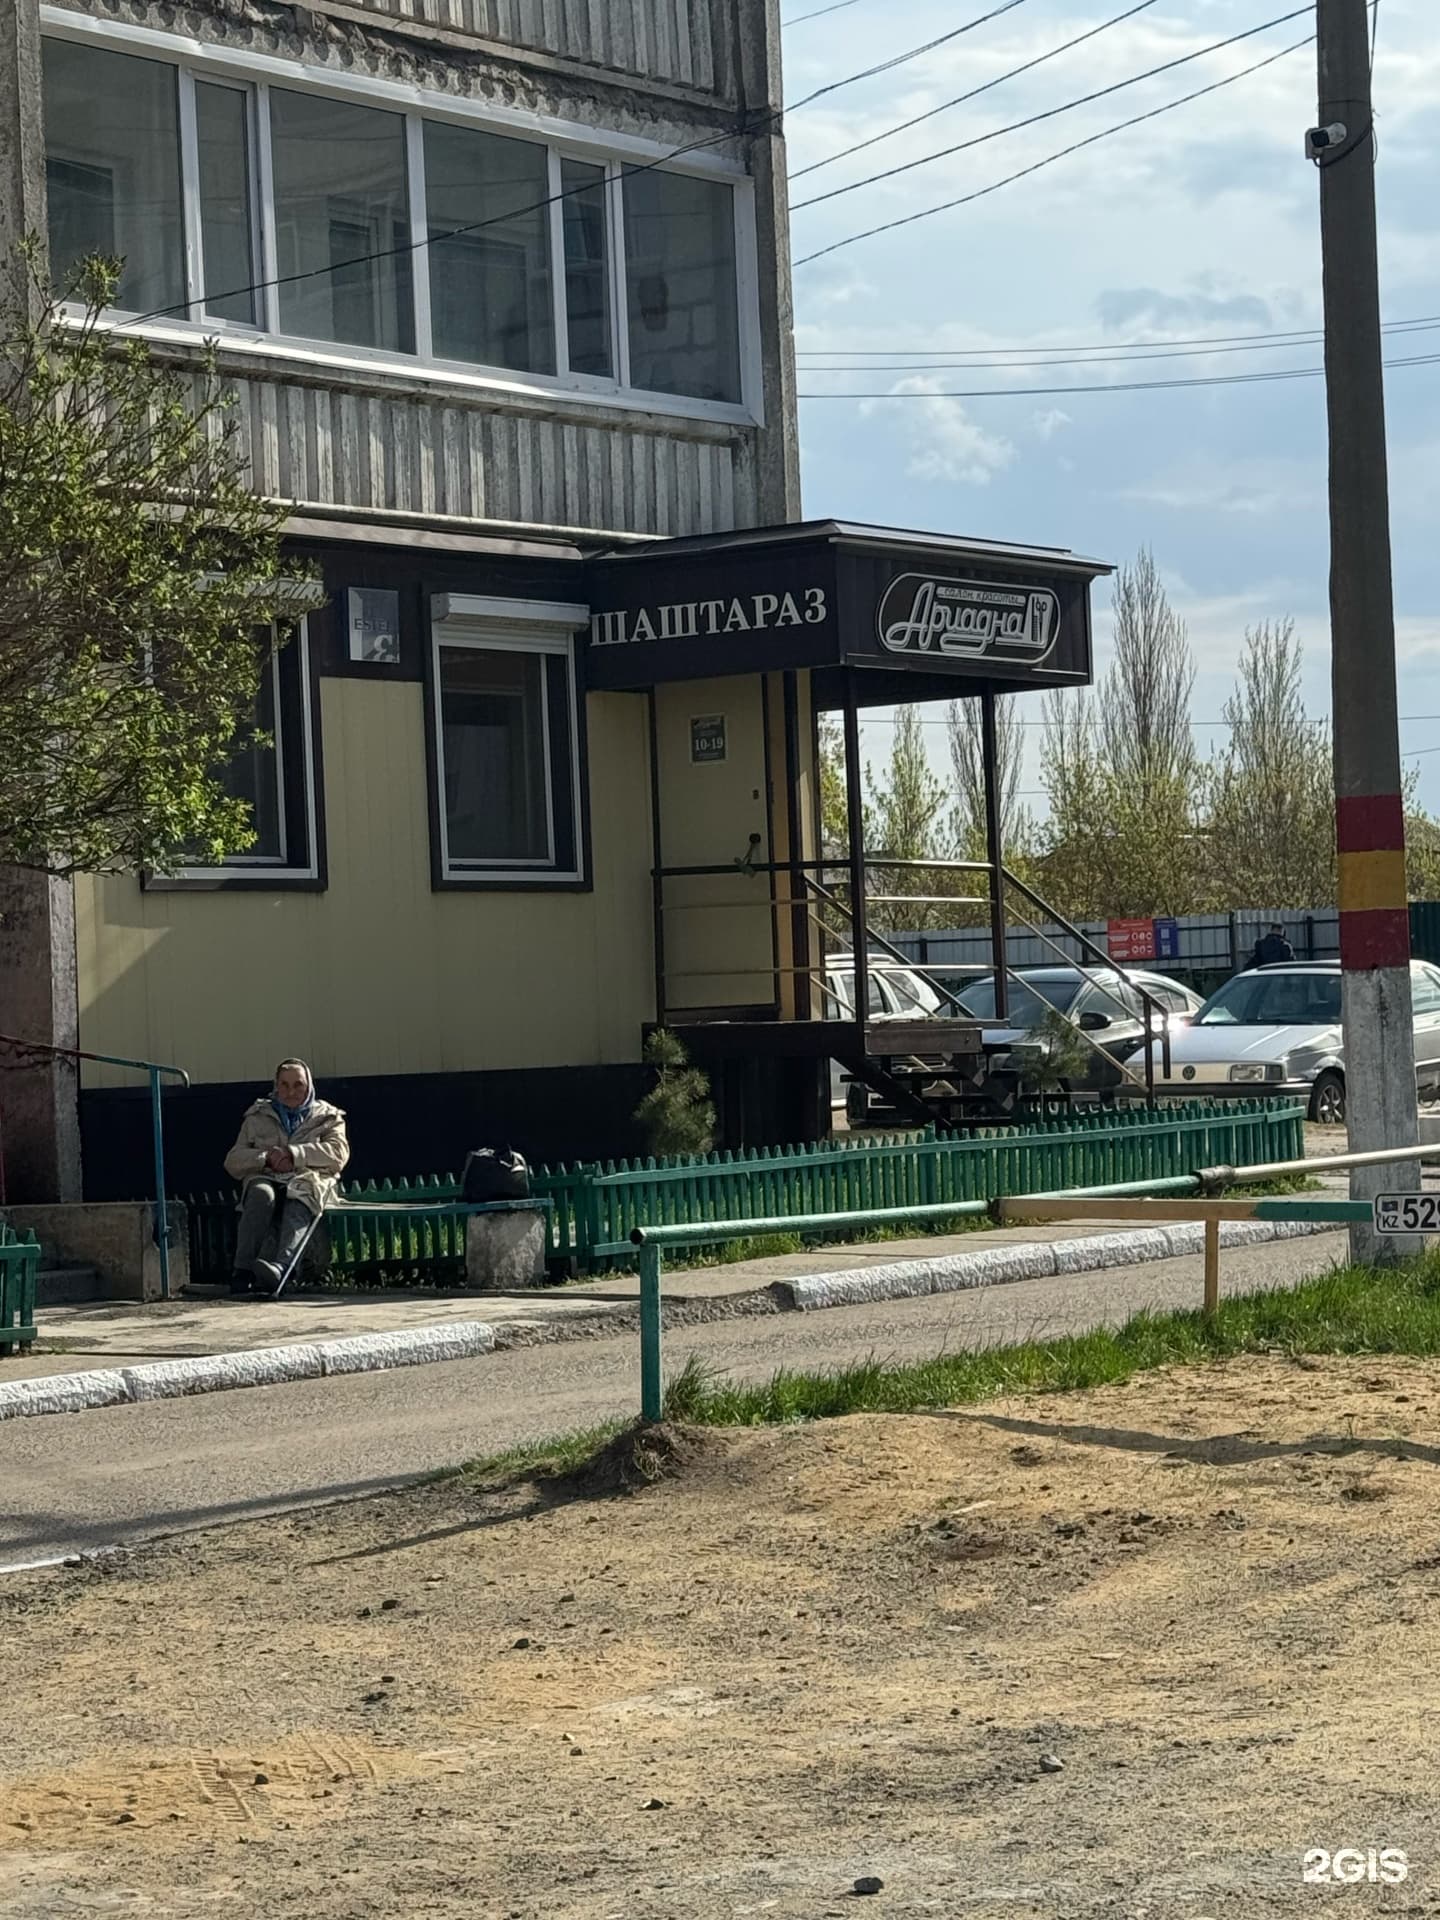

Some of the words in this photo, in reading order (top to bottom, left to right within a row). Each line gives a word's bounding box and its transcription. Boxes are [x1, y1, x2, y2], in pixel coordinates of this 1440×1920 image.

[589, 587, 828, 647] ШАШТАРАЗ
[886, 582, 1026, 655] Ариадна
[695, 736, 724, 751] 10-19
[1382, 1215, 1399, 1228] KZ
[1403, 1197, 1440, 1229] 52
